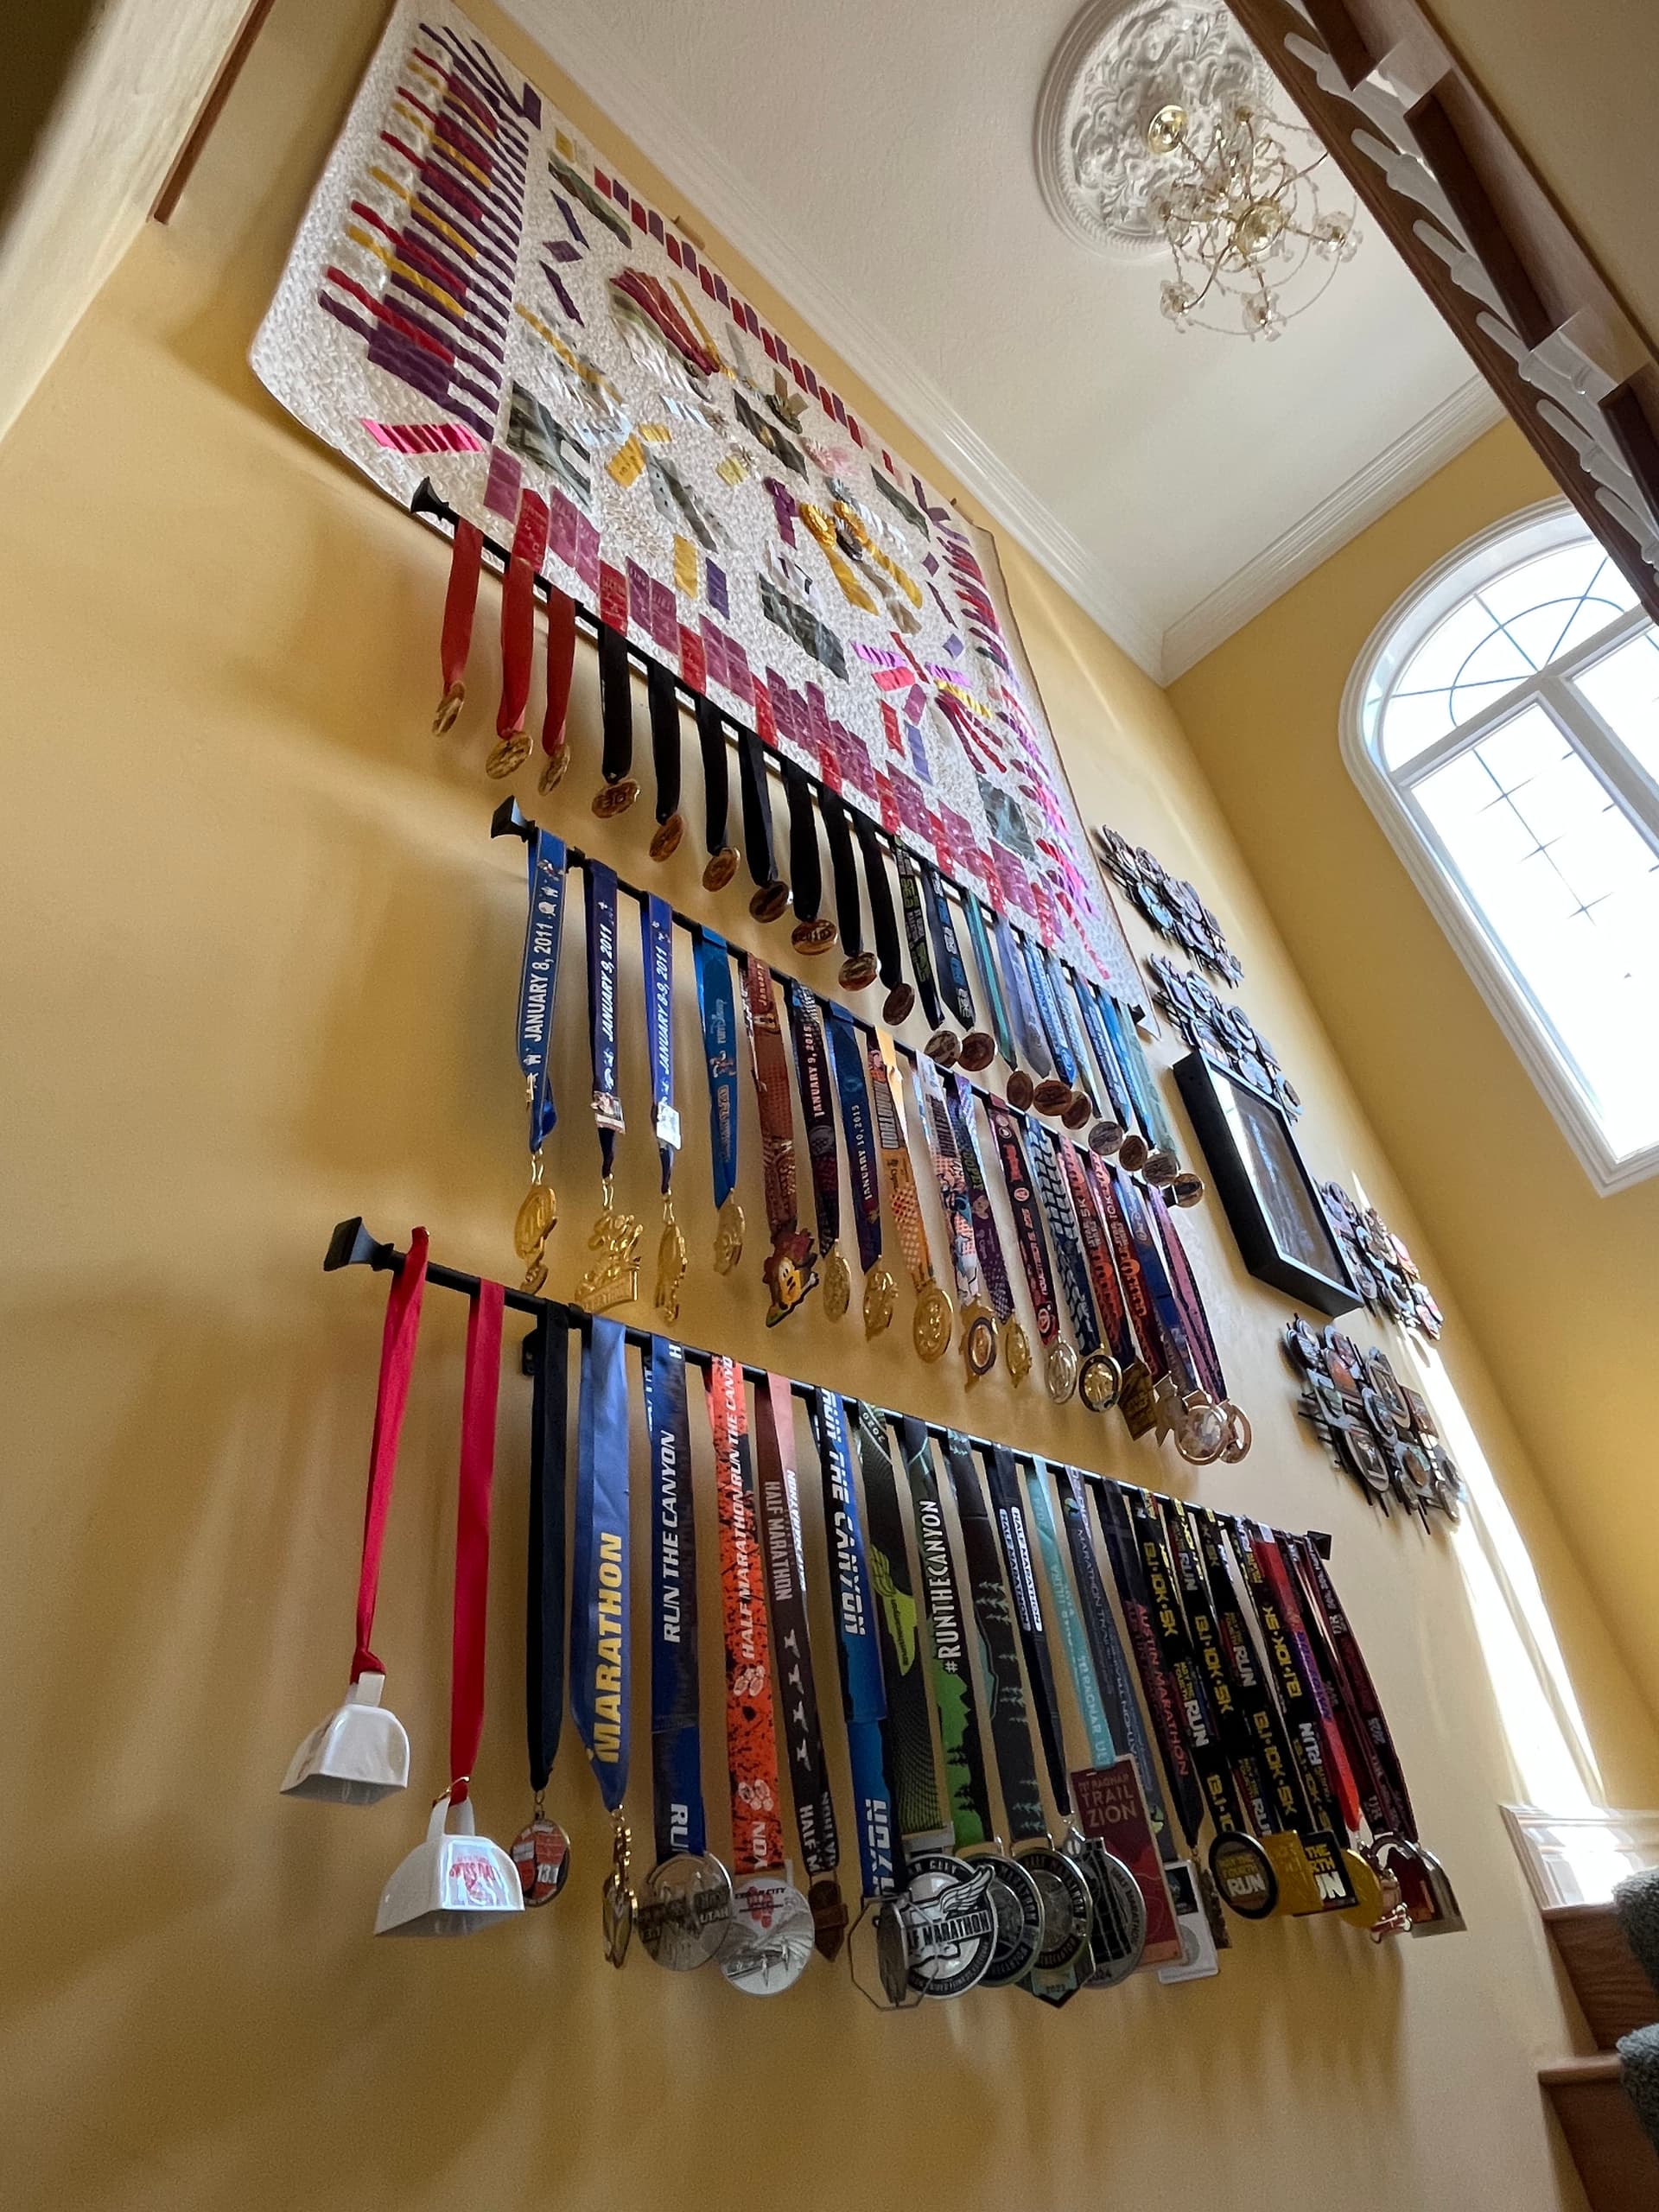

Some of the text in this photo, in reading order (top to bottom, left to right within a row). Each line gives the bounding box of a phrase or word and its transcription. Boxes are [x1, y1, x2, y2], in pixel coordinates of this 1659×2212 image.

[524, 922, 554, 1043] JANUARY 8, 2011
[600, 924, 613, 1043] JANUARY 9, 2011
[656, 945, 668, 980] 2011
[756, 963, 768, 1007] January
[657, 1007, 671, 1075] JANUARY
[803, 1025, 826, 1118] JANUARY 9, 2015
[873, 1081, 899, 1149] MARATHON
[850, 1104, 874, 1201] JANUARY 10, 2015
[962, 1150, 984, 1191] DOPEY
[1079, 1198, 1091, 1218] 5K
[1107, 1194, 1119, 1219] 10K
[861, 1411, 887, 1443] 2020
[829, 1450, 850, 1505] THE
[721, 1355, 755, 1660] HALF MARATHON RUN THE CANYO
[660, 1429, 682, 1643] RUN THE CANYON
[764, 1480, 794, 1602] HALF MARATHON
[833, 1510, 867, 1636] CANYON
[918, 1499, 962, 1675] #RUNTHECANYON
[1001, 1510, 1030, 1625] HALF MARATHON
[1014, 1510, 1042, 1625] HALF MARATHON
[1077, 1529, 1103, 1607] MARATHON
[1179, 1552, 1198, 1592] RUN
[1159, 1608, 1179, 1637] 5K
[1262, 1605, 1281, 1631] 5K
[593, 1531, 623, 1764] MARATHON
[1232, 1644, 1257, 1688] RUN
[1271, 1635, 1293, 1667] 10K
[1082, 1675, 1103, 1735] RAGNAR
[1137, 1602, 1160, 1666] AUSTIN
[1154, 1670, 1190, 1777] MARATHON
[1213, 1684, 1235, 1715] 5K
[1184, 1699, 1210, 1747] RUN
[1298, 1721, 1323, 1767] RUN
[1081, 1785, 1135, 1809] TRAIL
[1085, 1799, 1138, 1829] ZION
[1276, 1784, 1298, 1816] 5K
[752, 1821, 769, 1868] YON
[798, 1803, 817, 1850] HALF
[865, 1798, 895, 1897] NYON
[928, 1859, 958, 1875] CITY
[1222, 1863, 1261, 1880] FOURTH
[1305, 1842, 1332, 1859] THE
[1308, 1858, 1337, 1875] RTH
[537, 1864, 559, 1884] 13.1
[766, 1886, 786, 1897] CITY
[1224, 1873, 1267, 1898] RUN
[1315, 1873, 1347, 1900] UN
[699, 1906, 730, 1924] UTAH
[921, 1910, 991, 1946] MARATHON
